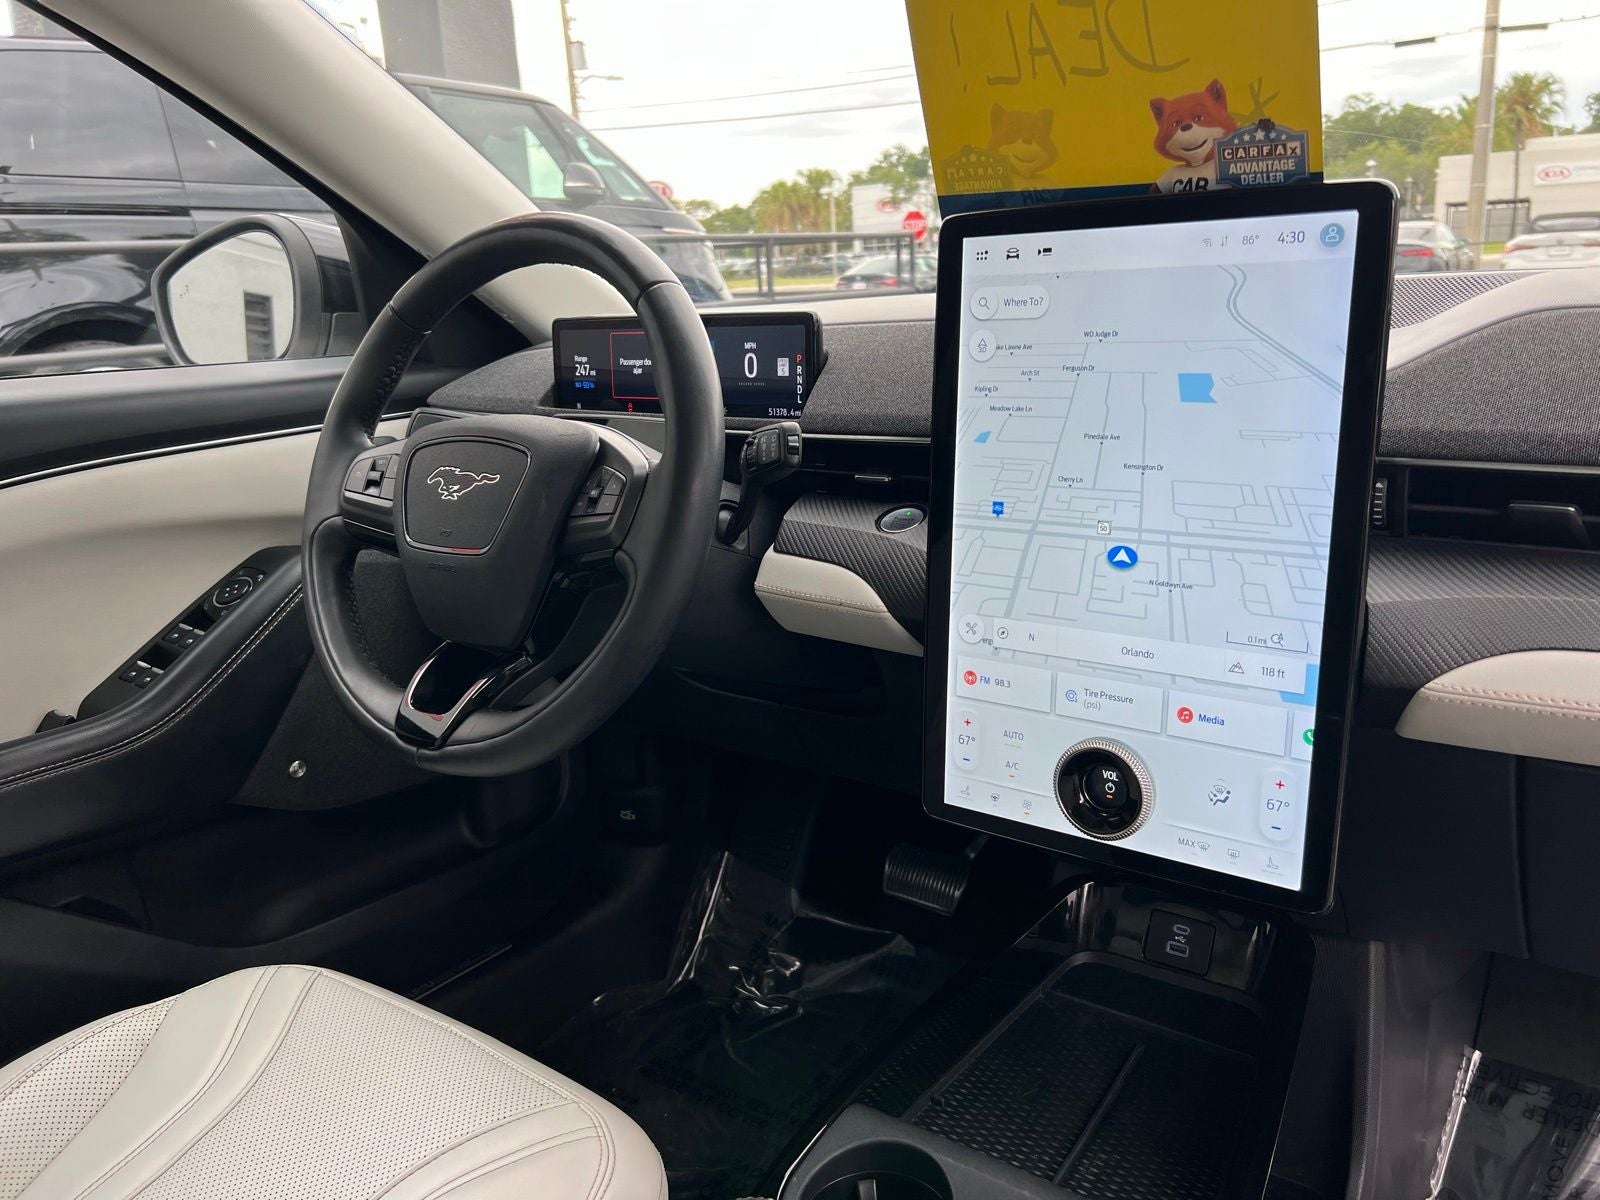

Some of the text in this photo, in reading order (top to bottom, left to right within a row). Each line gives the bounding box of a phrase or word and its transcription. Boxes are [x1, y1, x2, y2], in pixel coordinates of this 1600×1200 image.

[1223, 142, 1301, 161] CARFAX
[1229, 159, 1295, 174] ADVANTAGE
[1241, 173, 1284, 185] DEALER
[904, 219, 926, 231] STOP
[1277, 231, 1305, 244] 4:30
[1003, 297, 1043, 307] Where To?
[1095, 331, 1111, 339] Judge
[574, 355, 588, 363] Range
[619, 358, 643, 366] Passenger
[744, 352, 757, 378] 0
[575, 364, 590, 376] 247
[633, 367, 643, 375] ajar
[1123, 463, 1156, 472] Kensington
[1058, 476, 1074, 484] Cherry
[1155, 580, 1180, 589] Goldwyn
[1028, 633, 1035, 641] N
[1121, 646, 1155, 660] Orlando
[1262, 666, 1285, 679] 118 ft
[980, 676, 1011, 689] FM 98.3
[1084, 688, 1134, 704] Tire Pressure
[1084, 699, 1101, 712] (psi)
[1198, 712, 1225, 726] Media
[1003, 730, 1024, 741] AUTO
[1006, 761, 1019, 771] A/C
[1102, 769, 1119, 782] VOL
[1178, 837, 1196, 849] MAX
